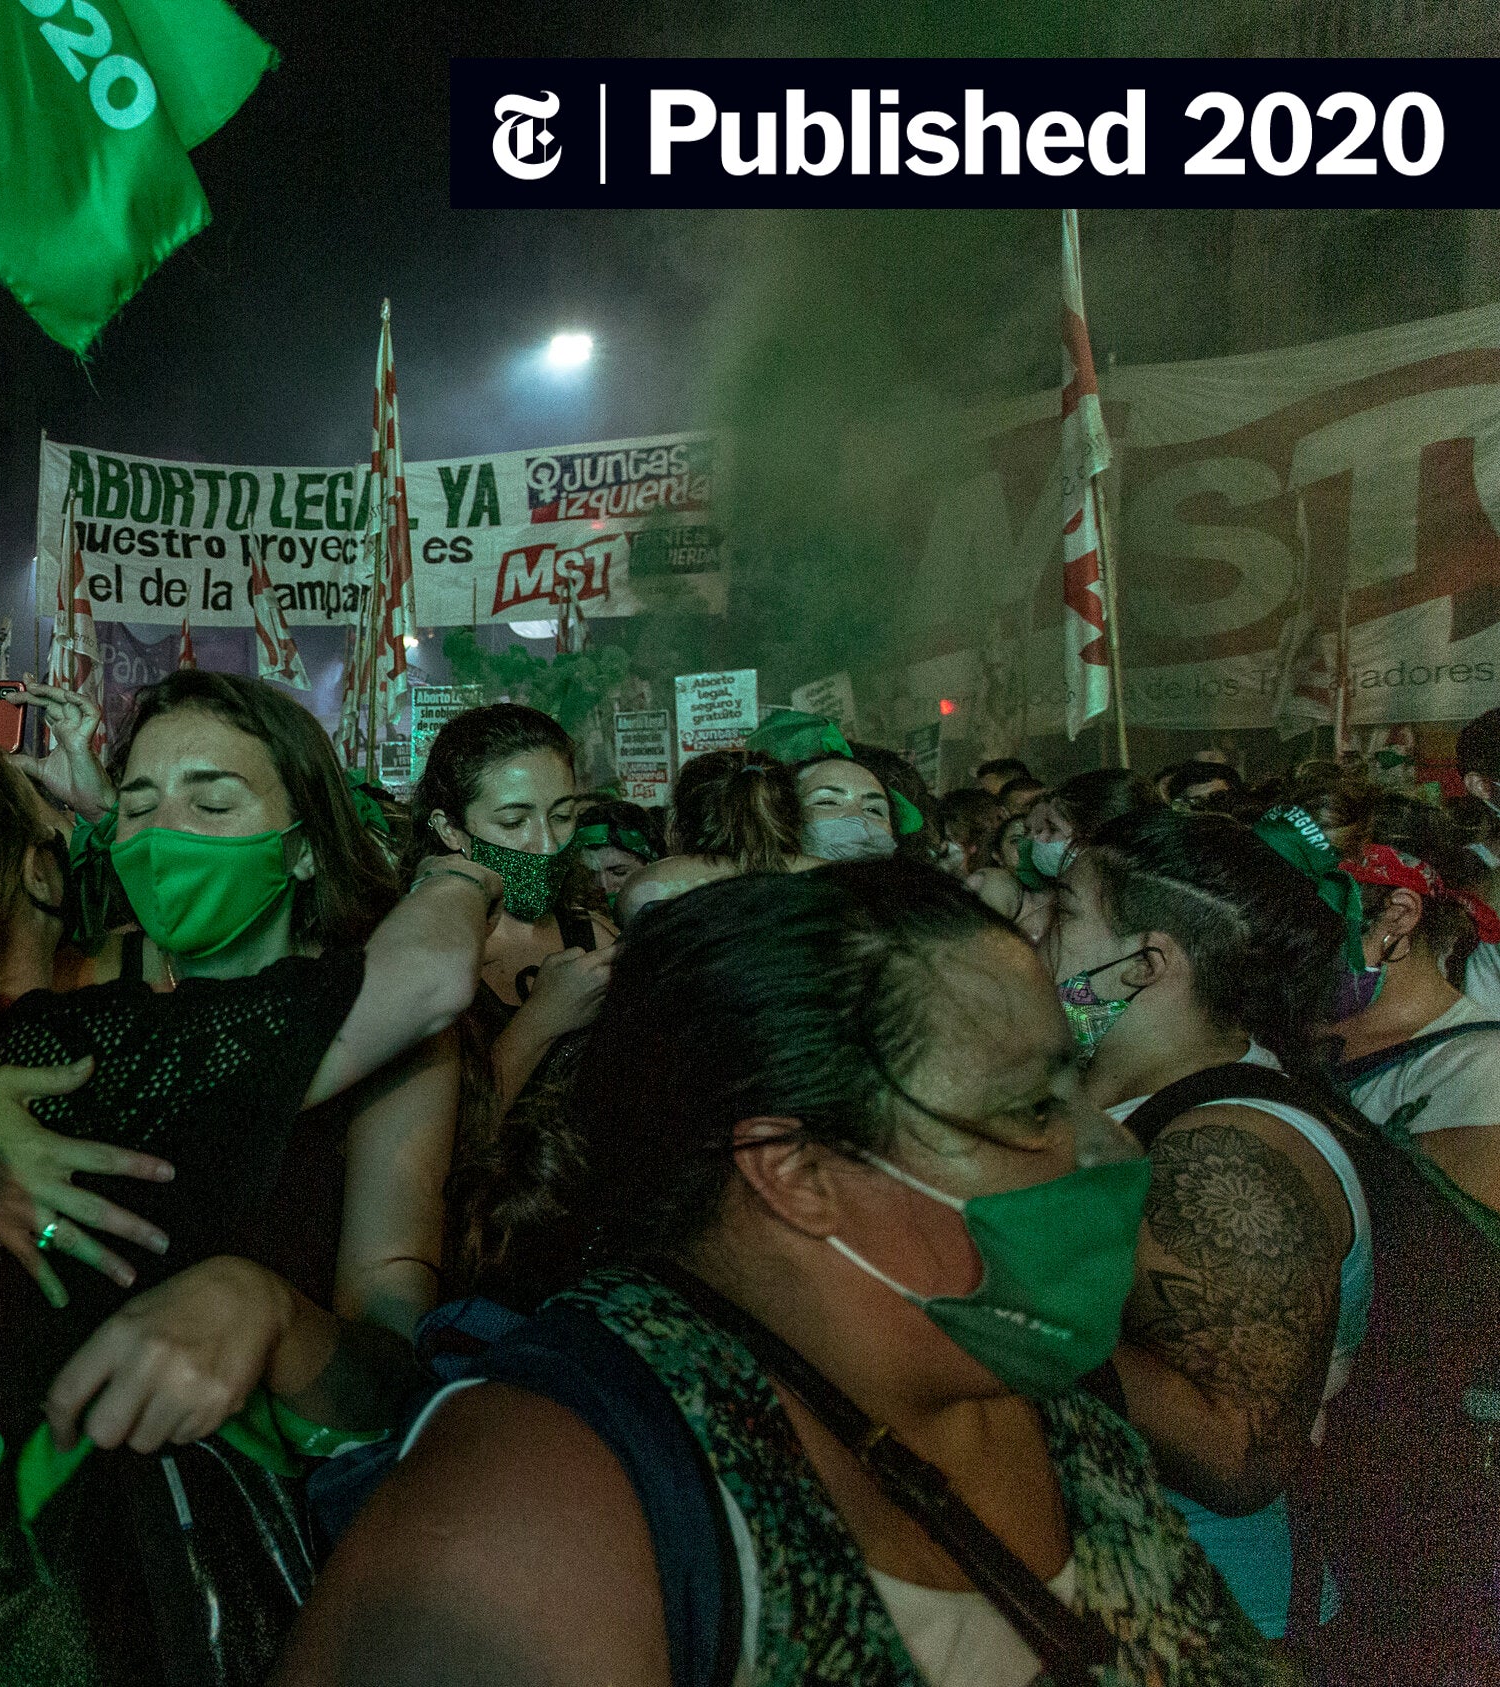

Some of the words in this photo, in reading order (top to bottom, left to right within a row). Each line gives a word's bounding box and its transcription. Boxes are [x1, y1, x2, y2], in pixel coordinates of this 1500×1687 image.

[19, 0, 157, 130] 20
[61, 449, 260, 531] ABORTO
[269, 470, 418, 531] LEGA
[438, 462, 501, 528] YA
[240, 531, 366, 568] proyec
[423, 535, 474, 564] es
[499, 533, 628, 606] MST
[88, 564, 122, 602] el
[139, 567, 188, 608] de
[202, 567, 233, 612] la
[247, 574, 372, 619] ampa
[417, 690, 451, 704] Aborto
[691, 675, 735, 689] Aborto
[1256, 657, 1495, 700] Trajadores
[420, 708, 434, 719] sin
[690, 699, 733, 713] seguro
[734, 698, 742, 709] y
